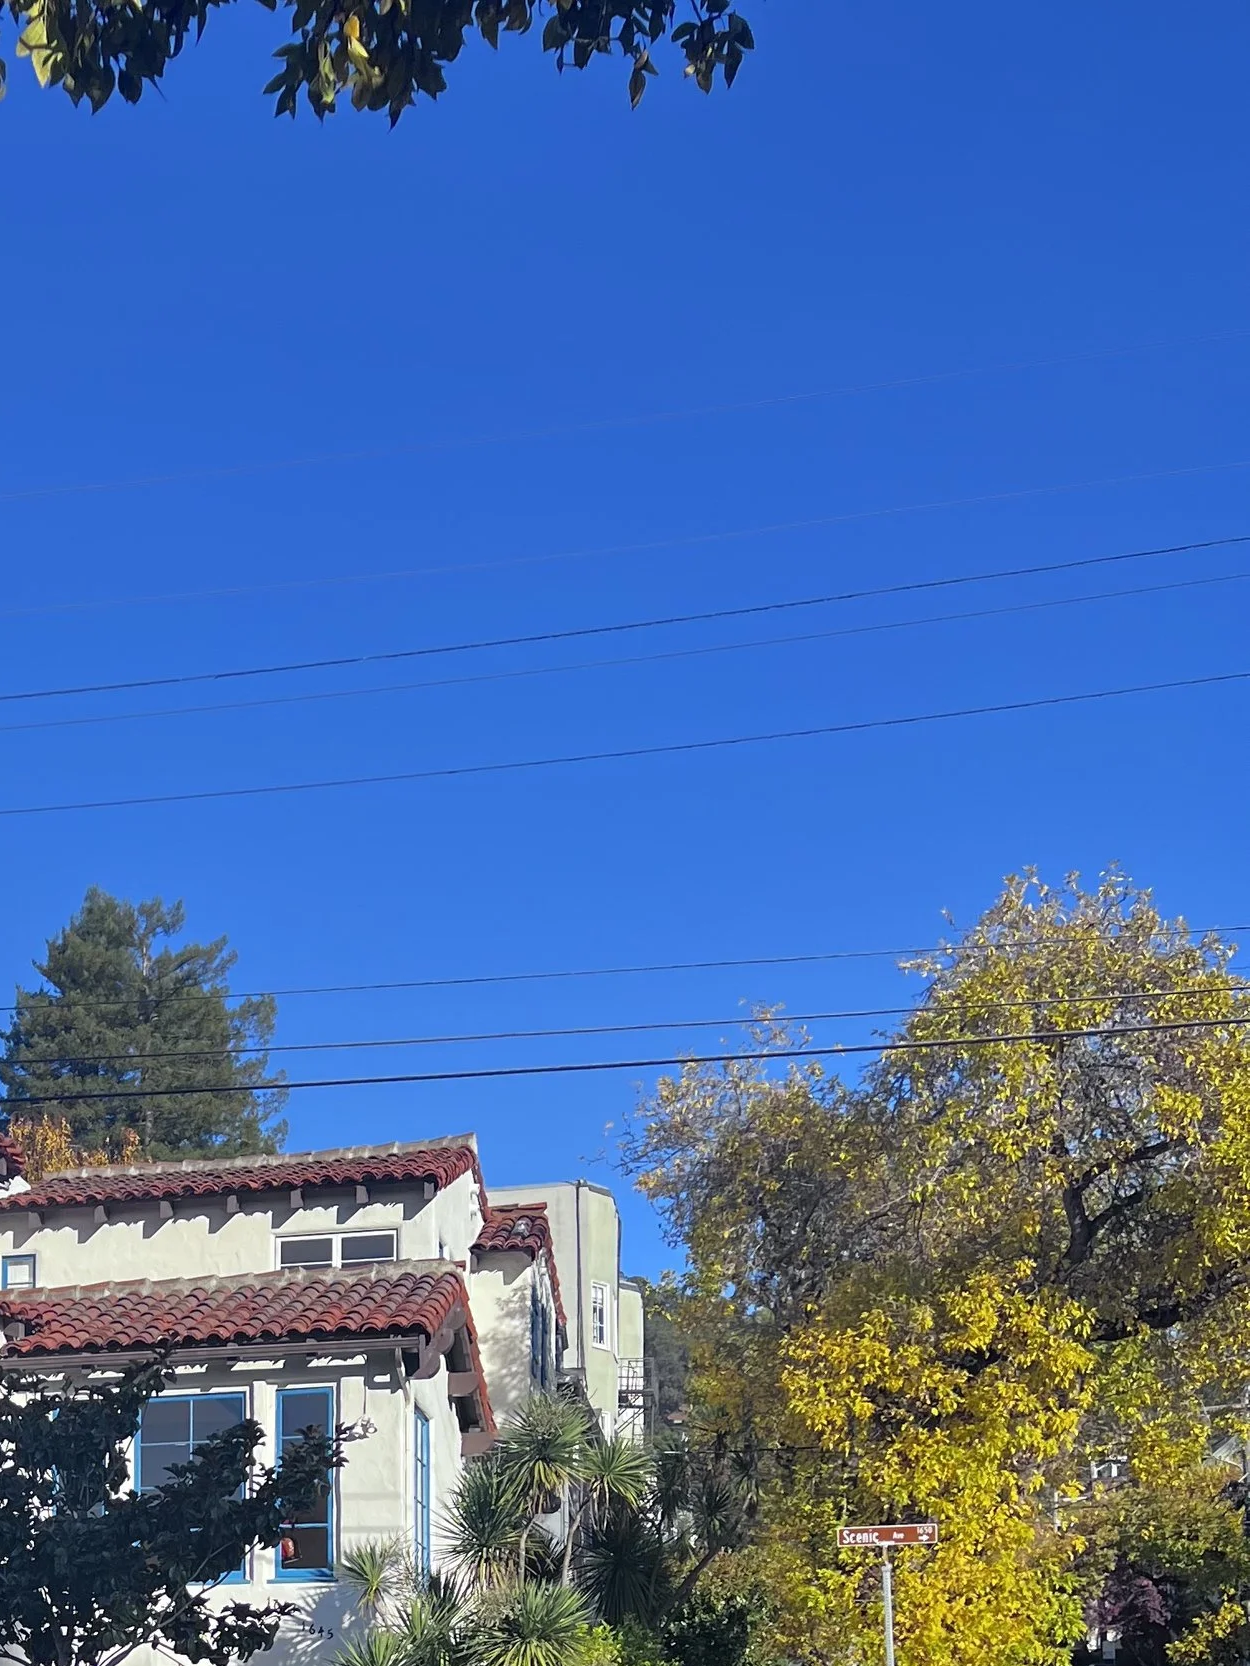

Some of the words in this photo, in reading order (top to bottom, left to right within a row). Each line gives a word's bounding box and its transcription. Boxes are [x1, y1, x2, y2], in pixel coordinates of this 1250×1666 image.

[842, 1530, 879, 1544] Scenic
[892, 1531, 905, 1539] Ave
[916, 1526, 933, 1534] 1650
[302, 1621, 333, 1639] 1645
